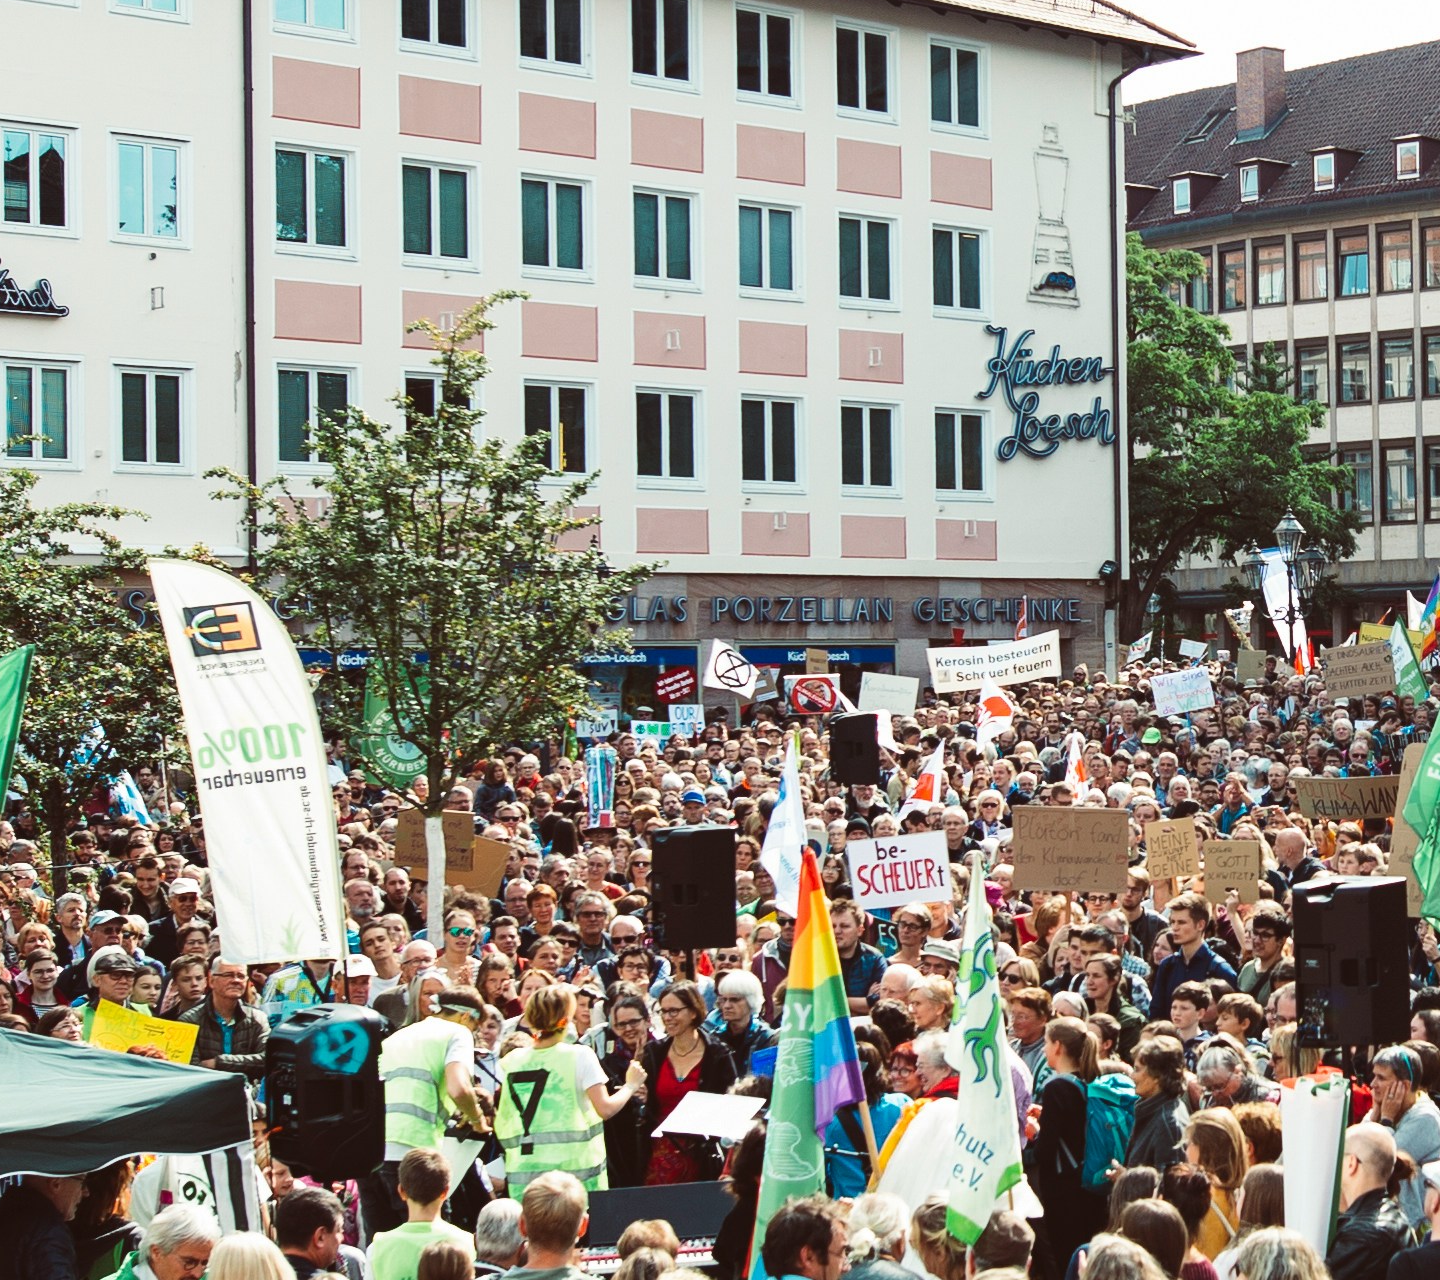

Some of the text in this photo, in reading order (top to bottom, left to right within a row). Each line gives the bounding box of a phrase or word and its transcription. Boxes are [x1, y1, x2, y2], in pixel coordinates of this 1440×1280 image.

[996, 392, 1116, 461] Loesch
[711, 595, 894, 623] PORZELLAN
[935, 642, 1052, 668] Kerosin besteuern
[1013, 658, 1053, 675] feuern
[1297, 780, 1353, 800] POLITIK
[1149, 831, 1192, 851] MEINE
[1153, 858, 1193, 877] DEINE
[1216, 855, 1251, 869] GOTT
